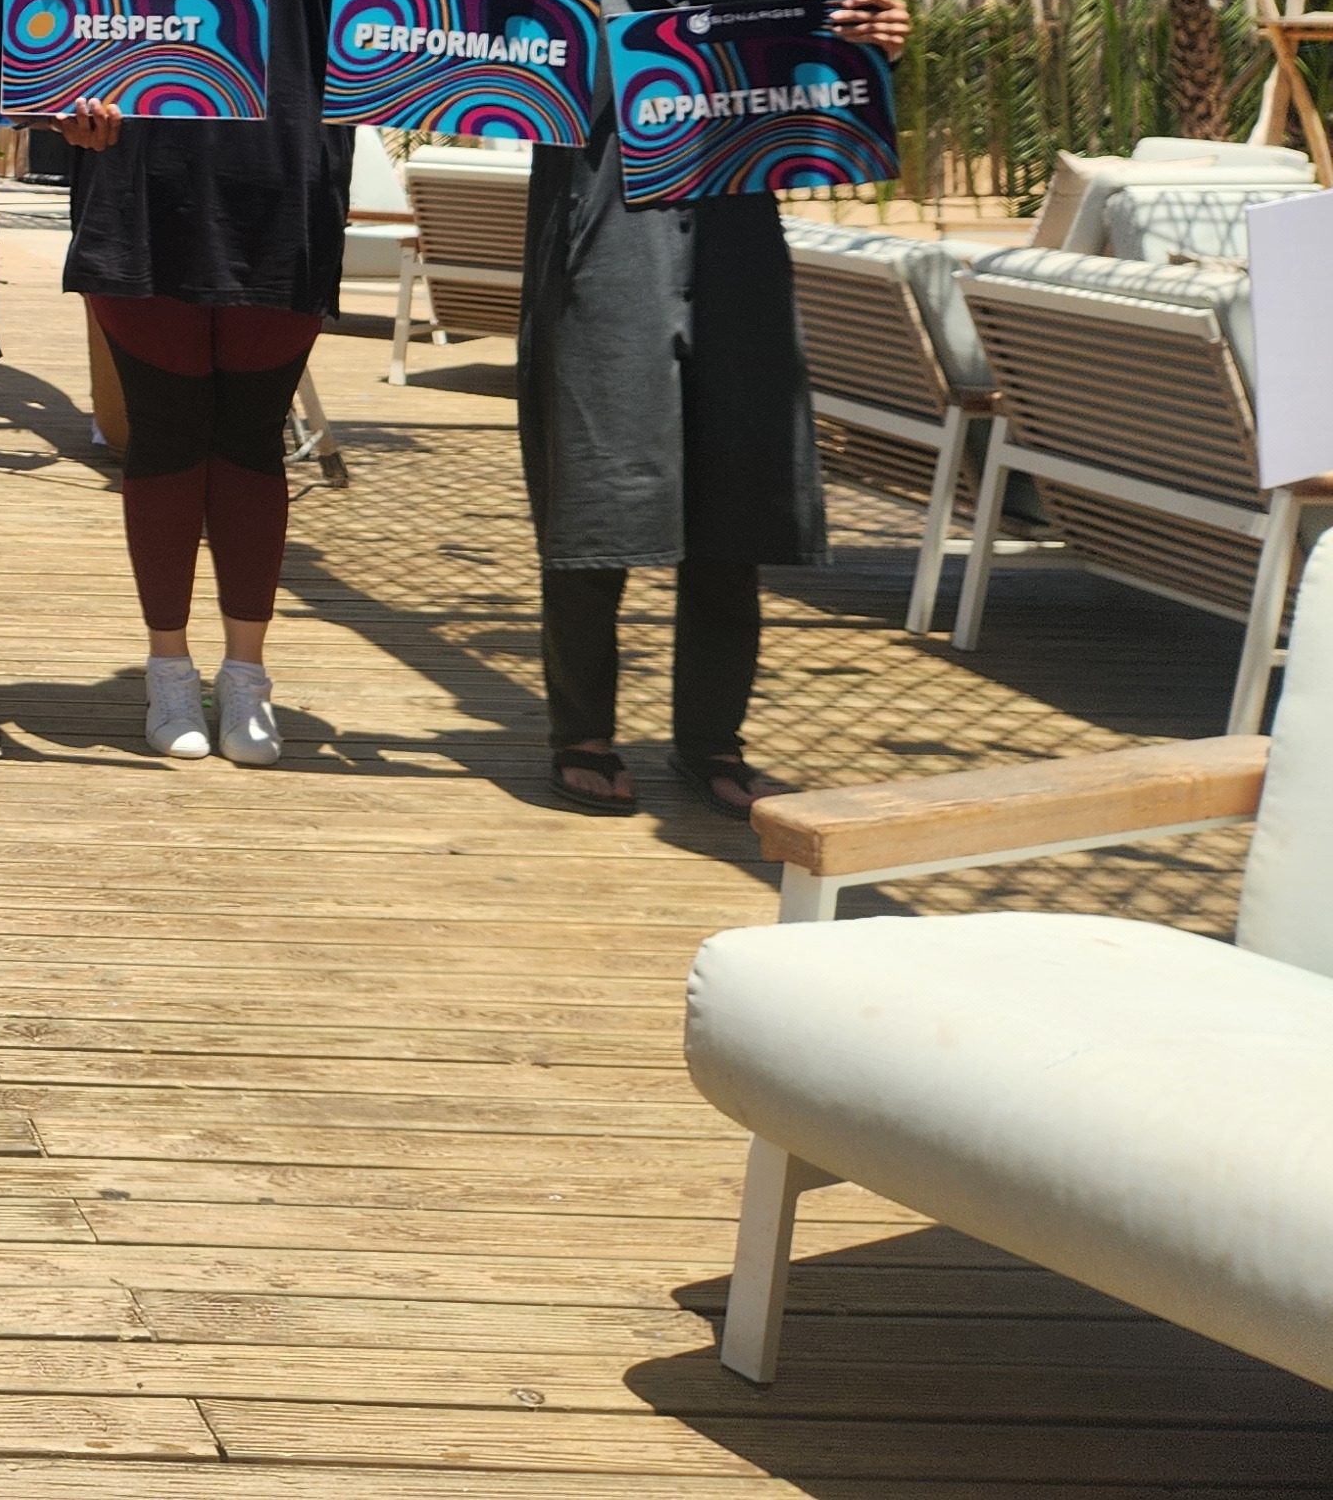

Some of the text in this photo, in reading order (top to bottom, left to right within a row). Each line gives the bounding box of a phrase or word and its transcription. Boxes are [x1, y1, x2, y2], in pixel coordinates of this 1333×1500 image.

[73, 14, 200, 41] RESPECT
[354, 23, 568, 67] PERFORMANCE
[637, 78, 870, 125] APPARTENANCE
